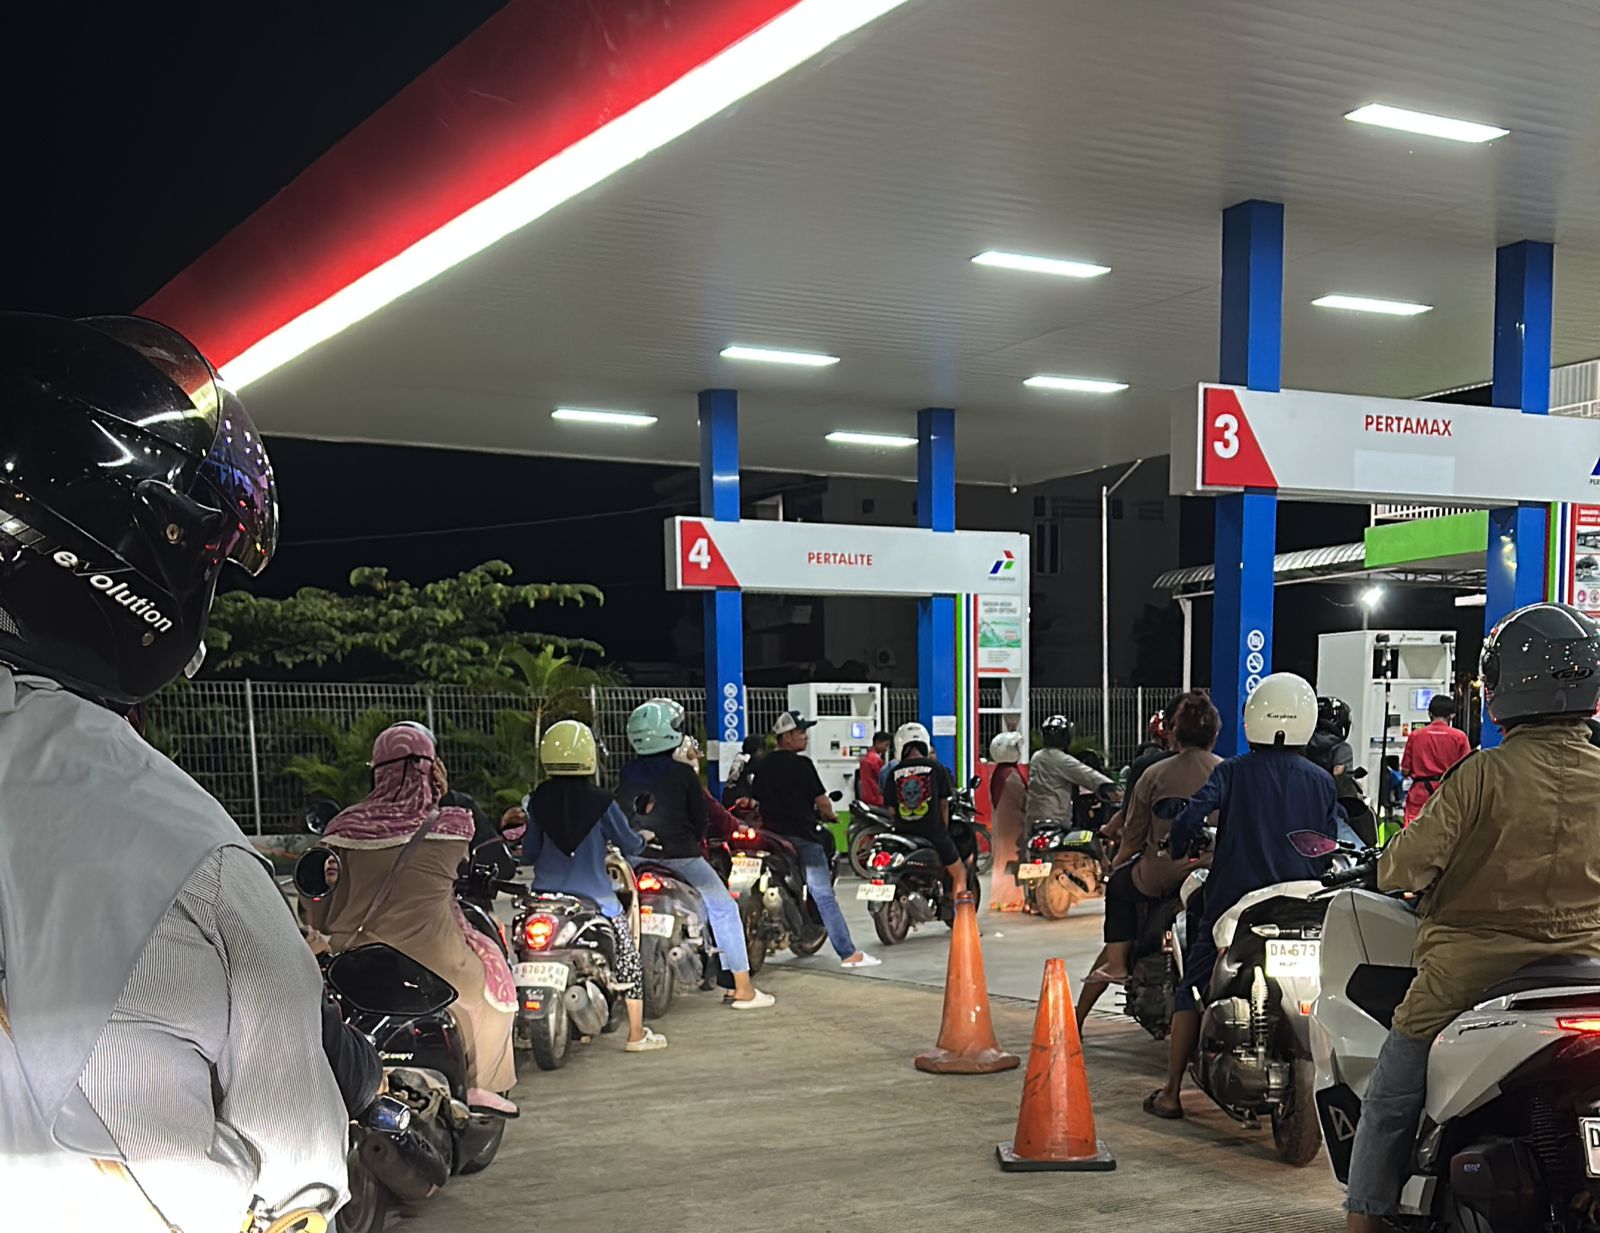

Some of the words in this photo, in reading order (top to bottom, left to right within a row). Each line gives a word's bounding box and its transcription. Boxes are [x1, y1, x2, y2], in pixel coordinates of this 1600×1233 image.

[1213, 413, 1240, 459] 3
[1365, 414, 1453, 437] PERTAMAX
[688, 537, 711, 570] 4
[807, 551, 873, 567] PERTALITE
[1270, 943, 1287, 956] DA
